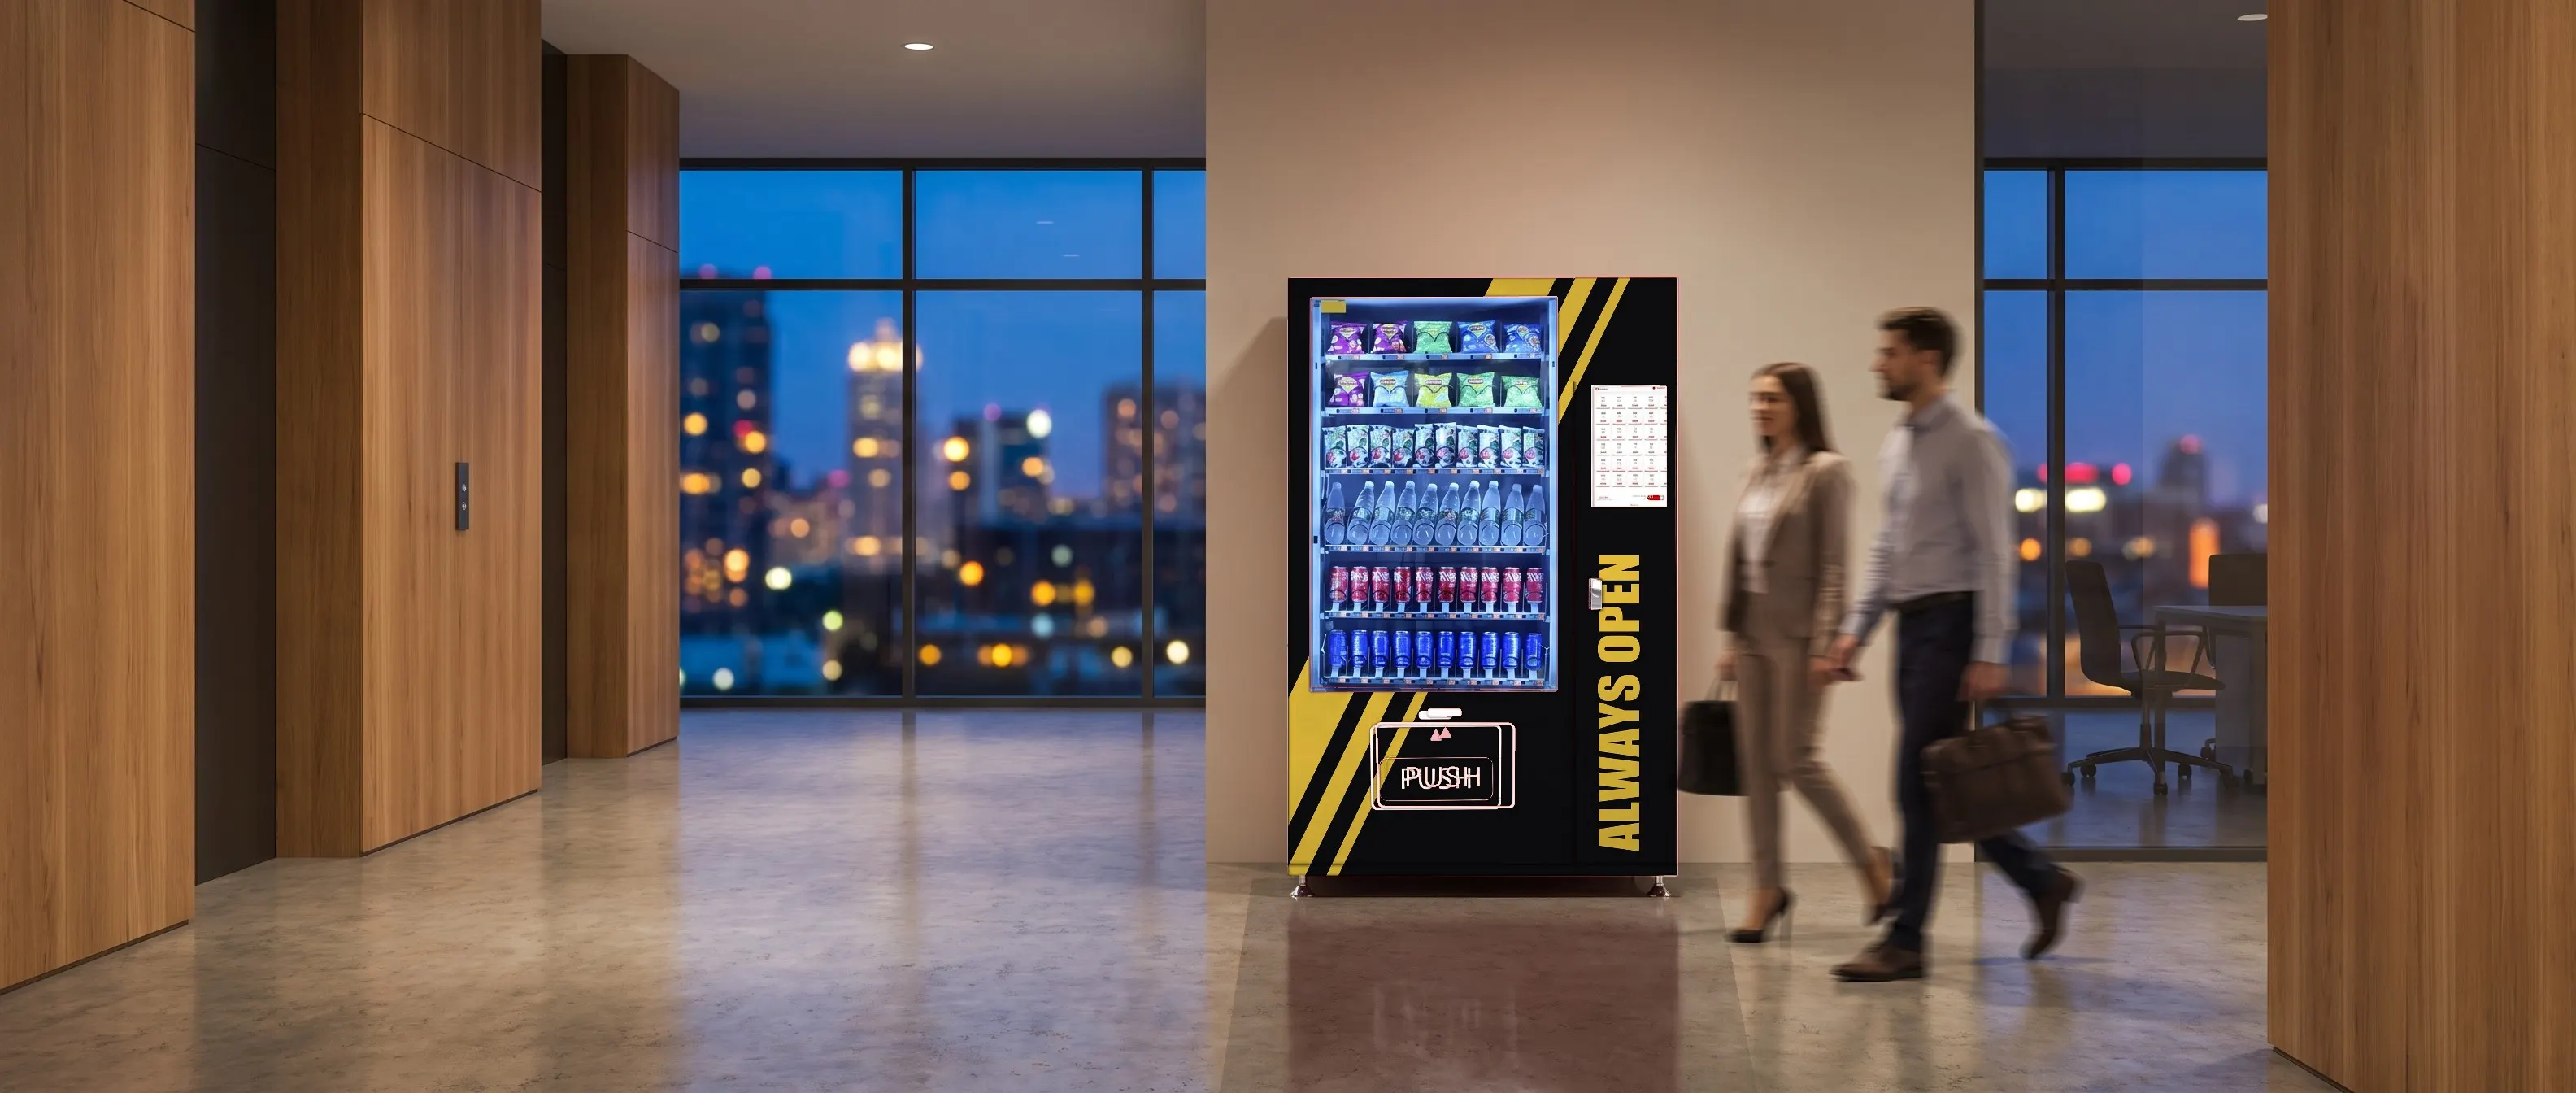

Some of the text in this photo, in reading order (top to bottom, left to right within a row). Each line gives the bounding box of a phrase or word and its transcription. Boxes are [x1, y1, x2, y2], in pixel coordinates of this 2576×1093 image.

[1401, 766, 1481, 790] PUSH
[1598, 555, 1640, 851] ALWAYS OPEN
